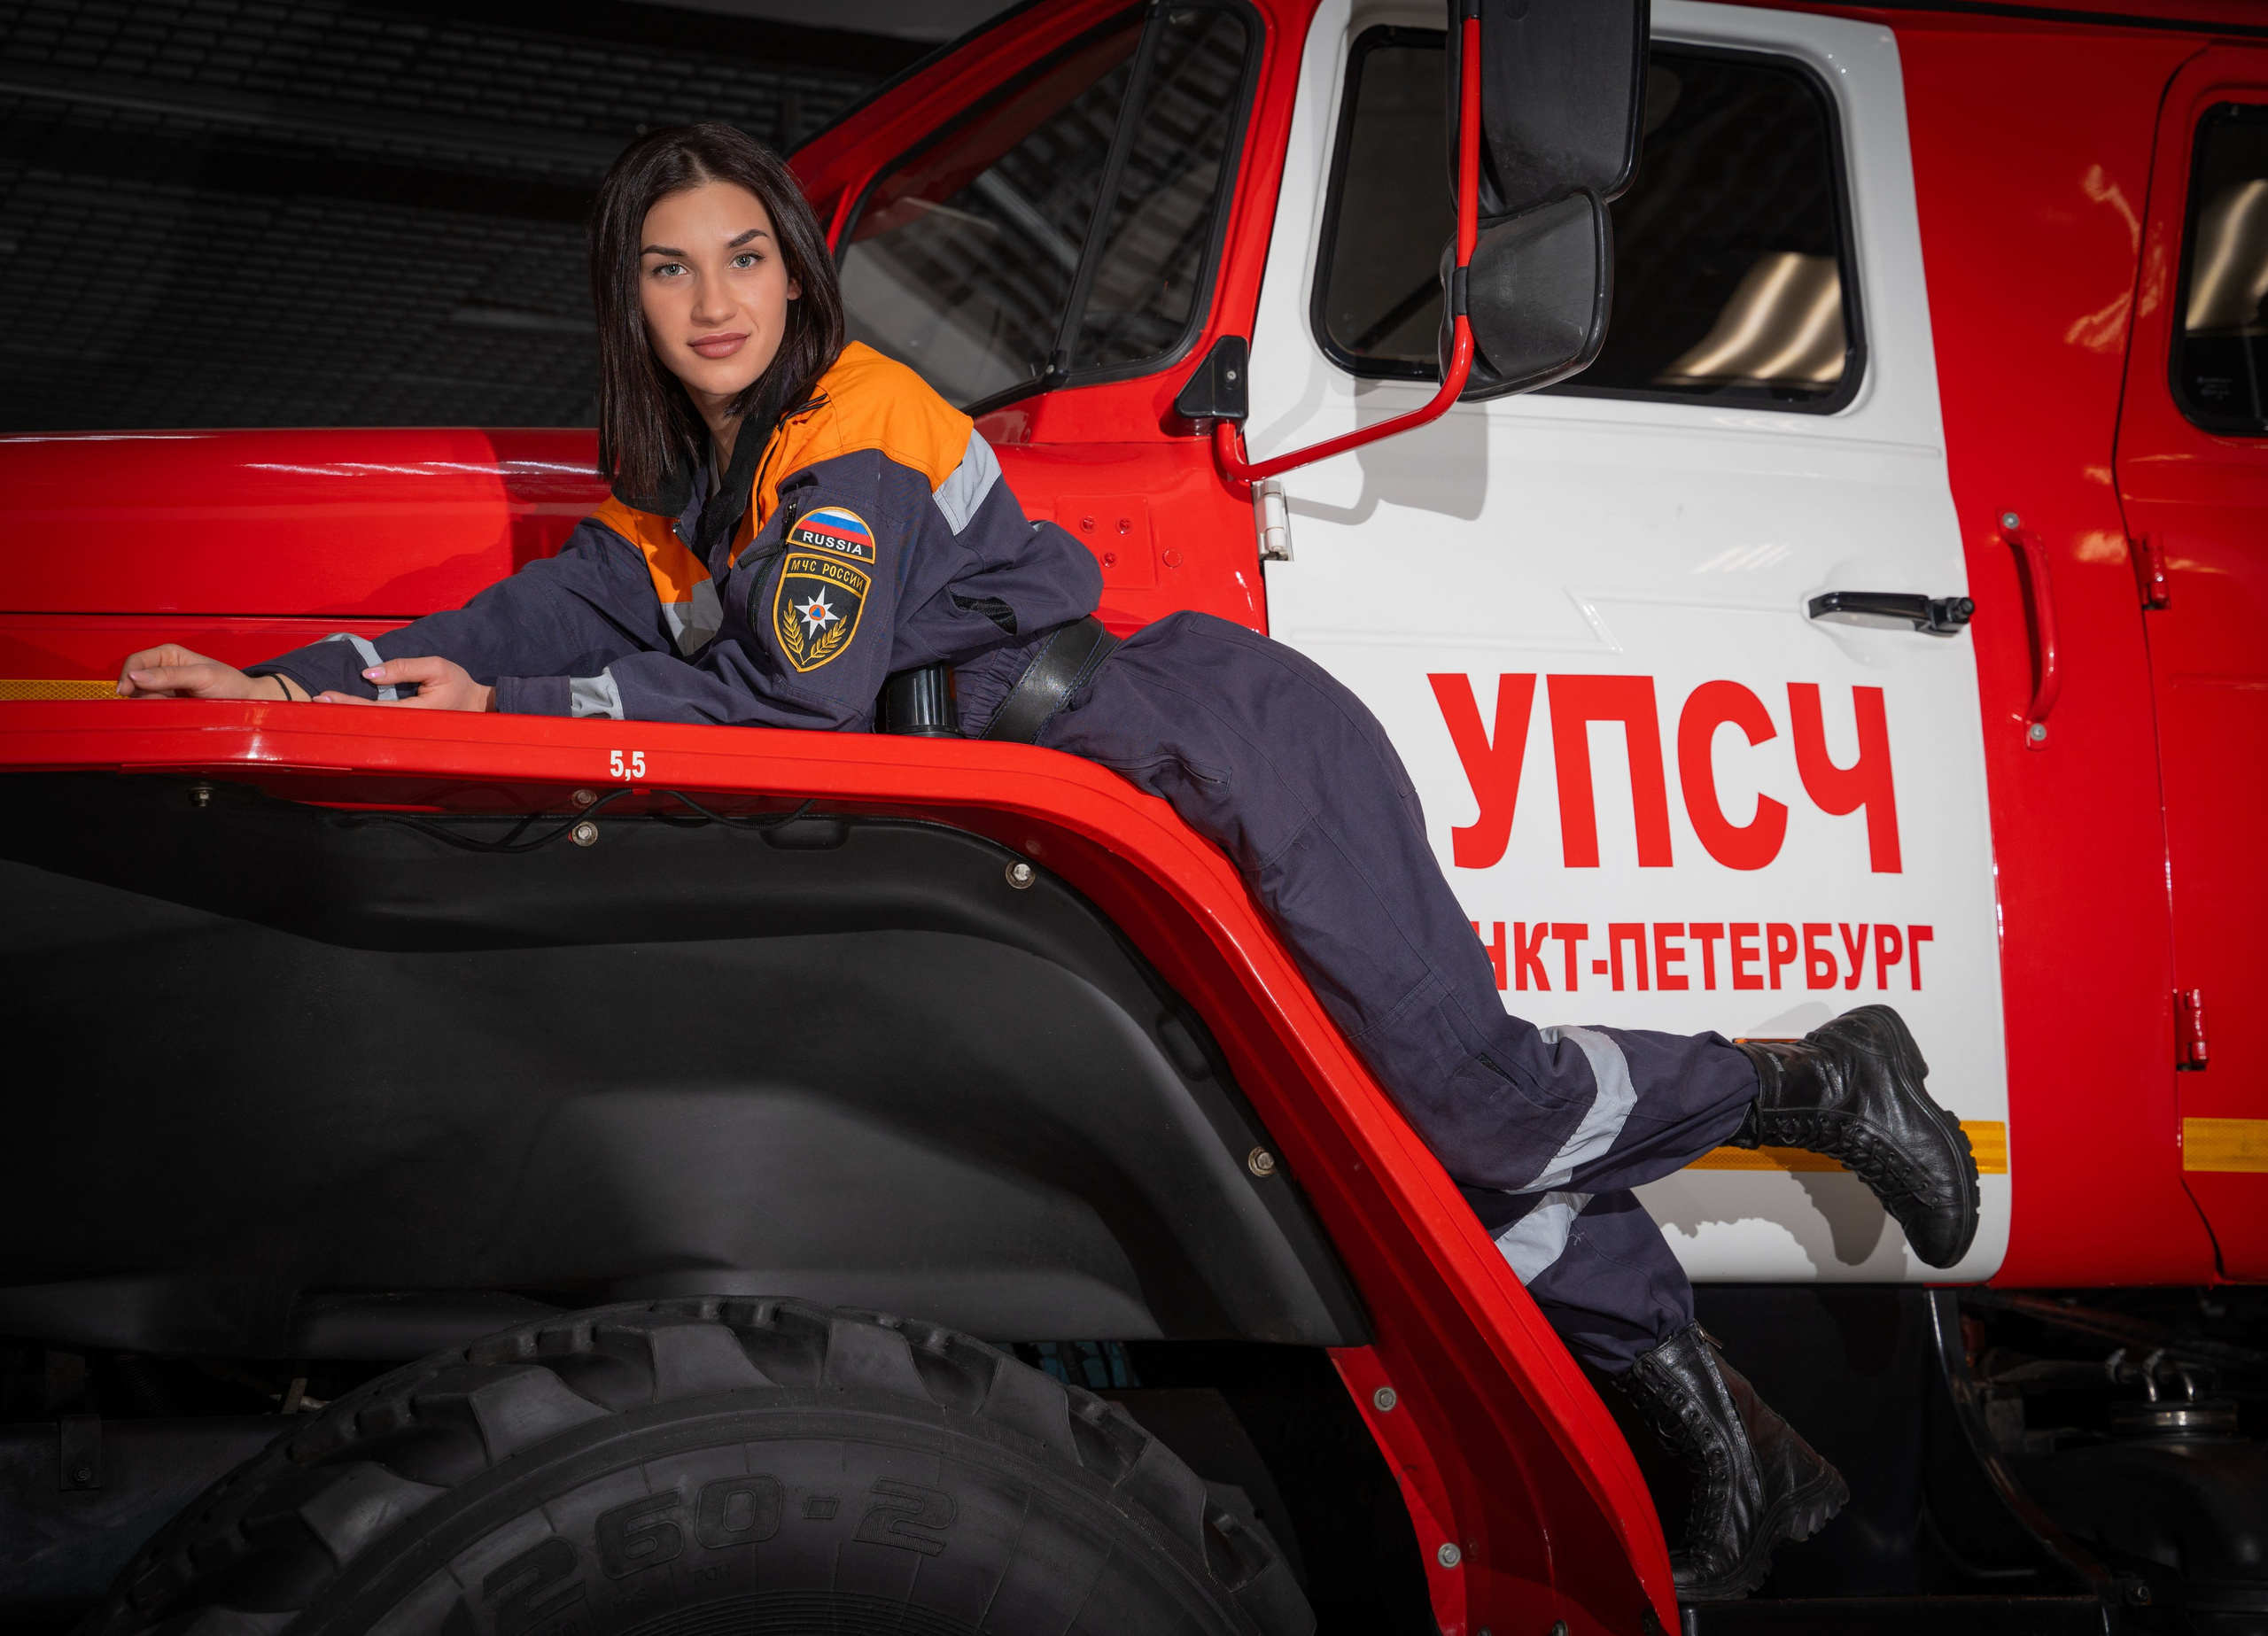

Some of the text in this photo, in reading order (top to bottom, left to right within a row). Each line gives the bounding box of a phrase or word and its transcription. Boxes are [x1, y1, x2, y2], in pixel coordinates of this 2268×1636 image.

[803, 531, 862, 556] RUSSIA
[790, 559, 864, 591] МЧС РОССИИ
[610, 749, 646, 781] 5,5
[1426, 673, 1903, 874] УПСЧ
